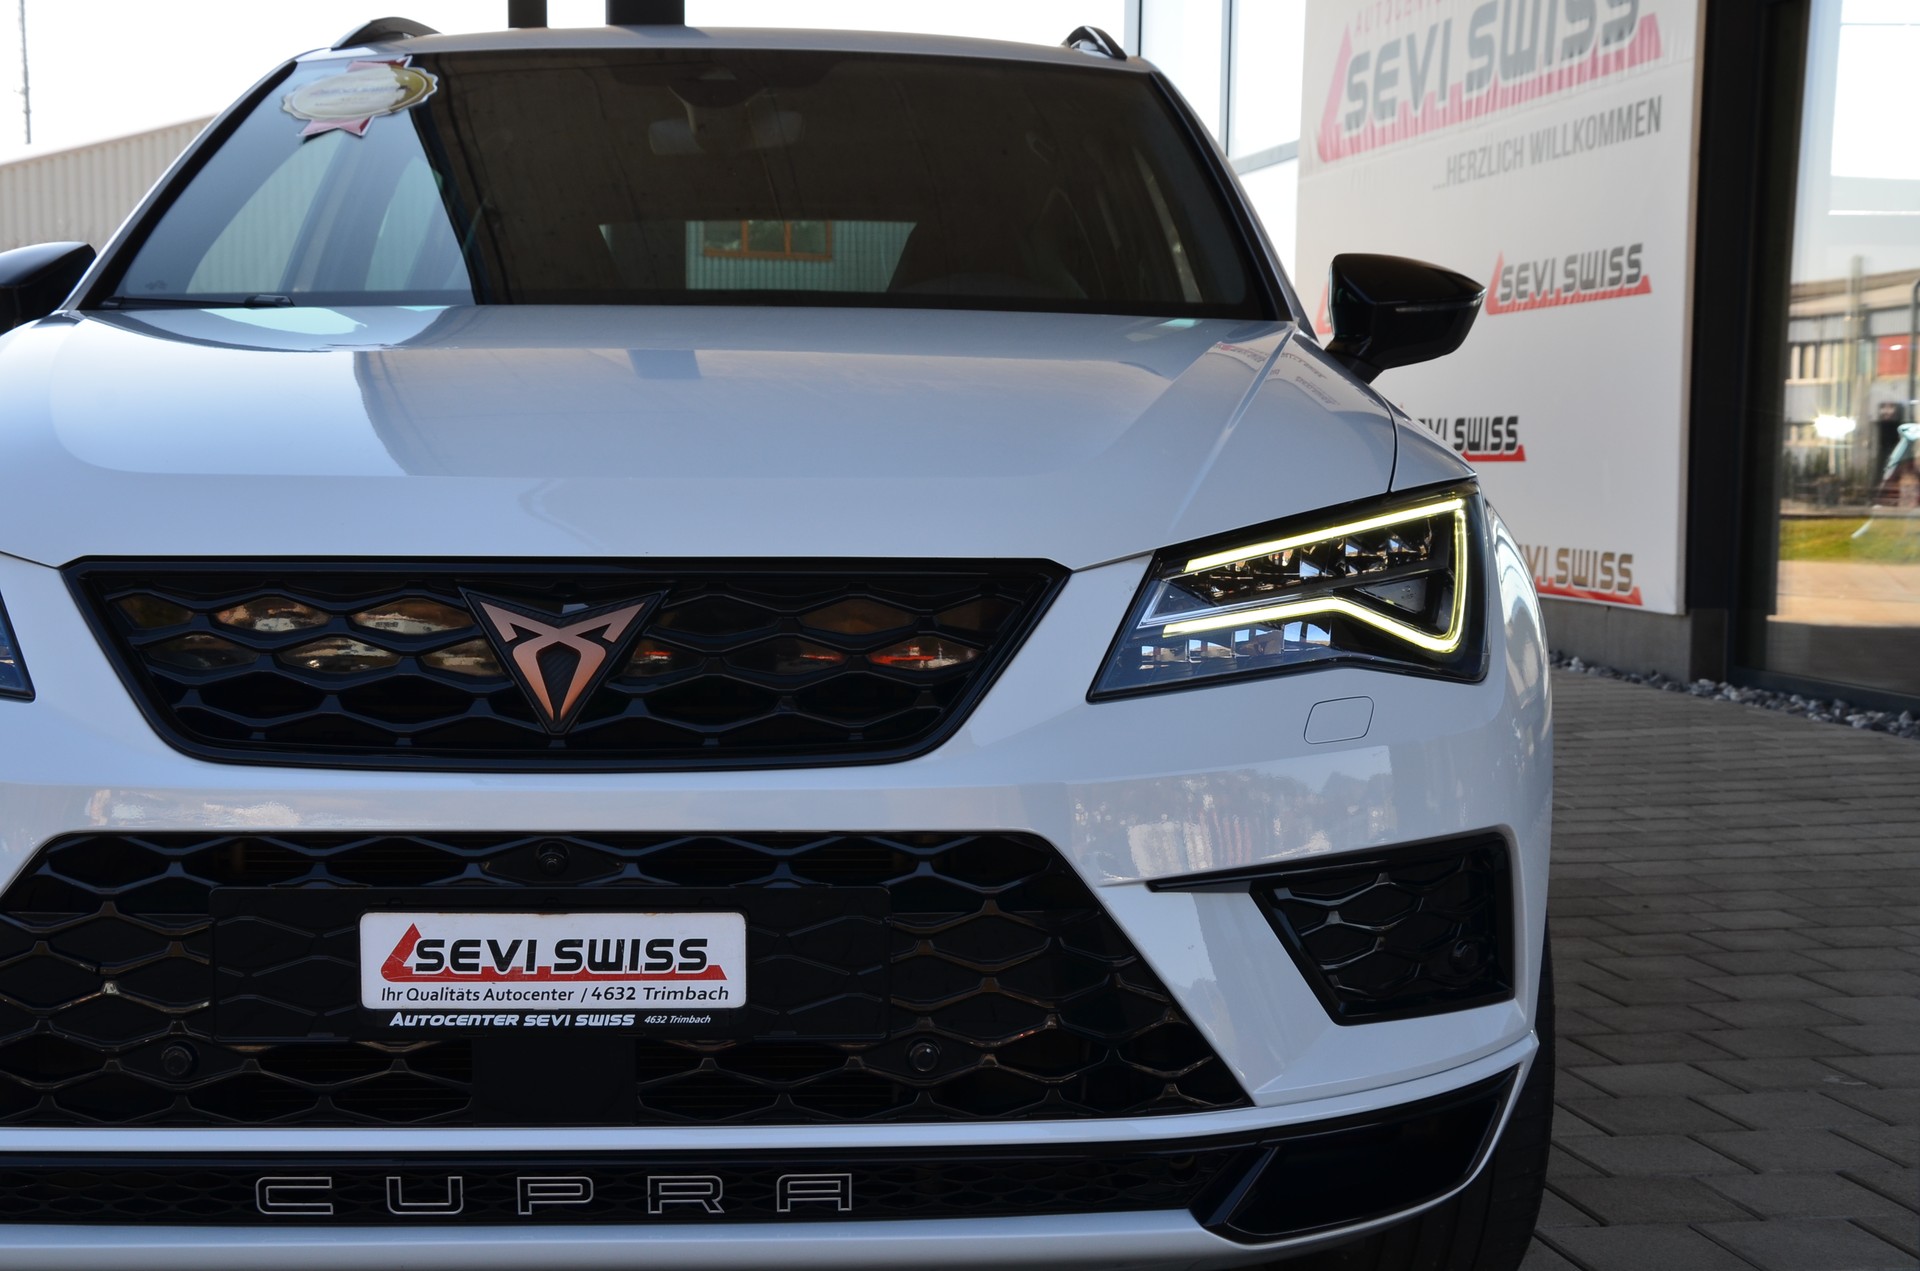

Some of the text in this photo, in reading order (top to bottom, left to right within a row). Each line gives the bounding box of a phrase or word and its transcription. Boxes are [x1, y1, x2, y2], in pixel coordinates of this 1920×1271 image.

[1344, 17, 1453, 132] SEVI
[1530, 95, 1663, 165] WILLKOMMEN
[1500, 243, 1643, 302] SEVI SWISS
[1453, 416, 1518, 451] SWISS
[1556, 548, 1633, 592] SWISS
[415, 938, 708, 972] SEVI SWISS
[381, 987, 403, 1001] Ihr
[406, 987, 480, 1002] Qualitäts
[483, 987, 574, 1001] Autocenter
[591, 986, 636, 1001] 4632
[643, 986, 729, 1001] Trimbach
[389, 1012, 711, 1027] AUTOCENTER SEVI SWISS 4632 Trimbach
[256, 1173, 853, 1215] CUPRA
